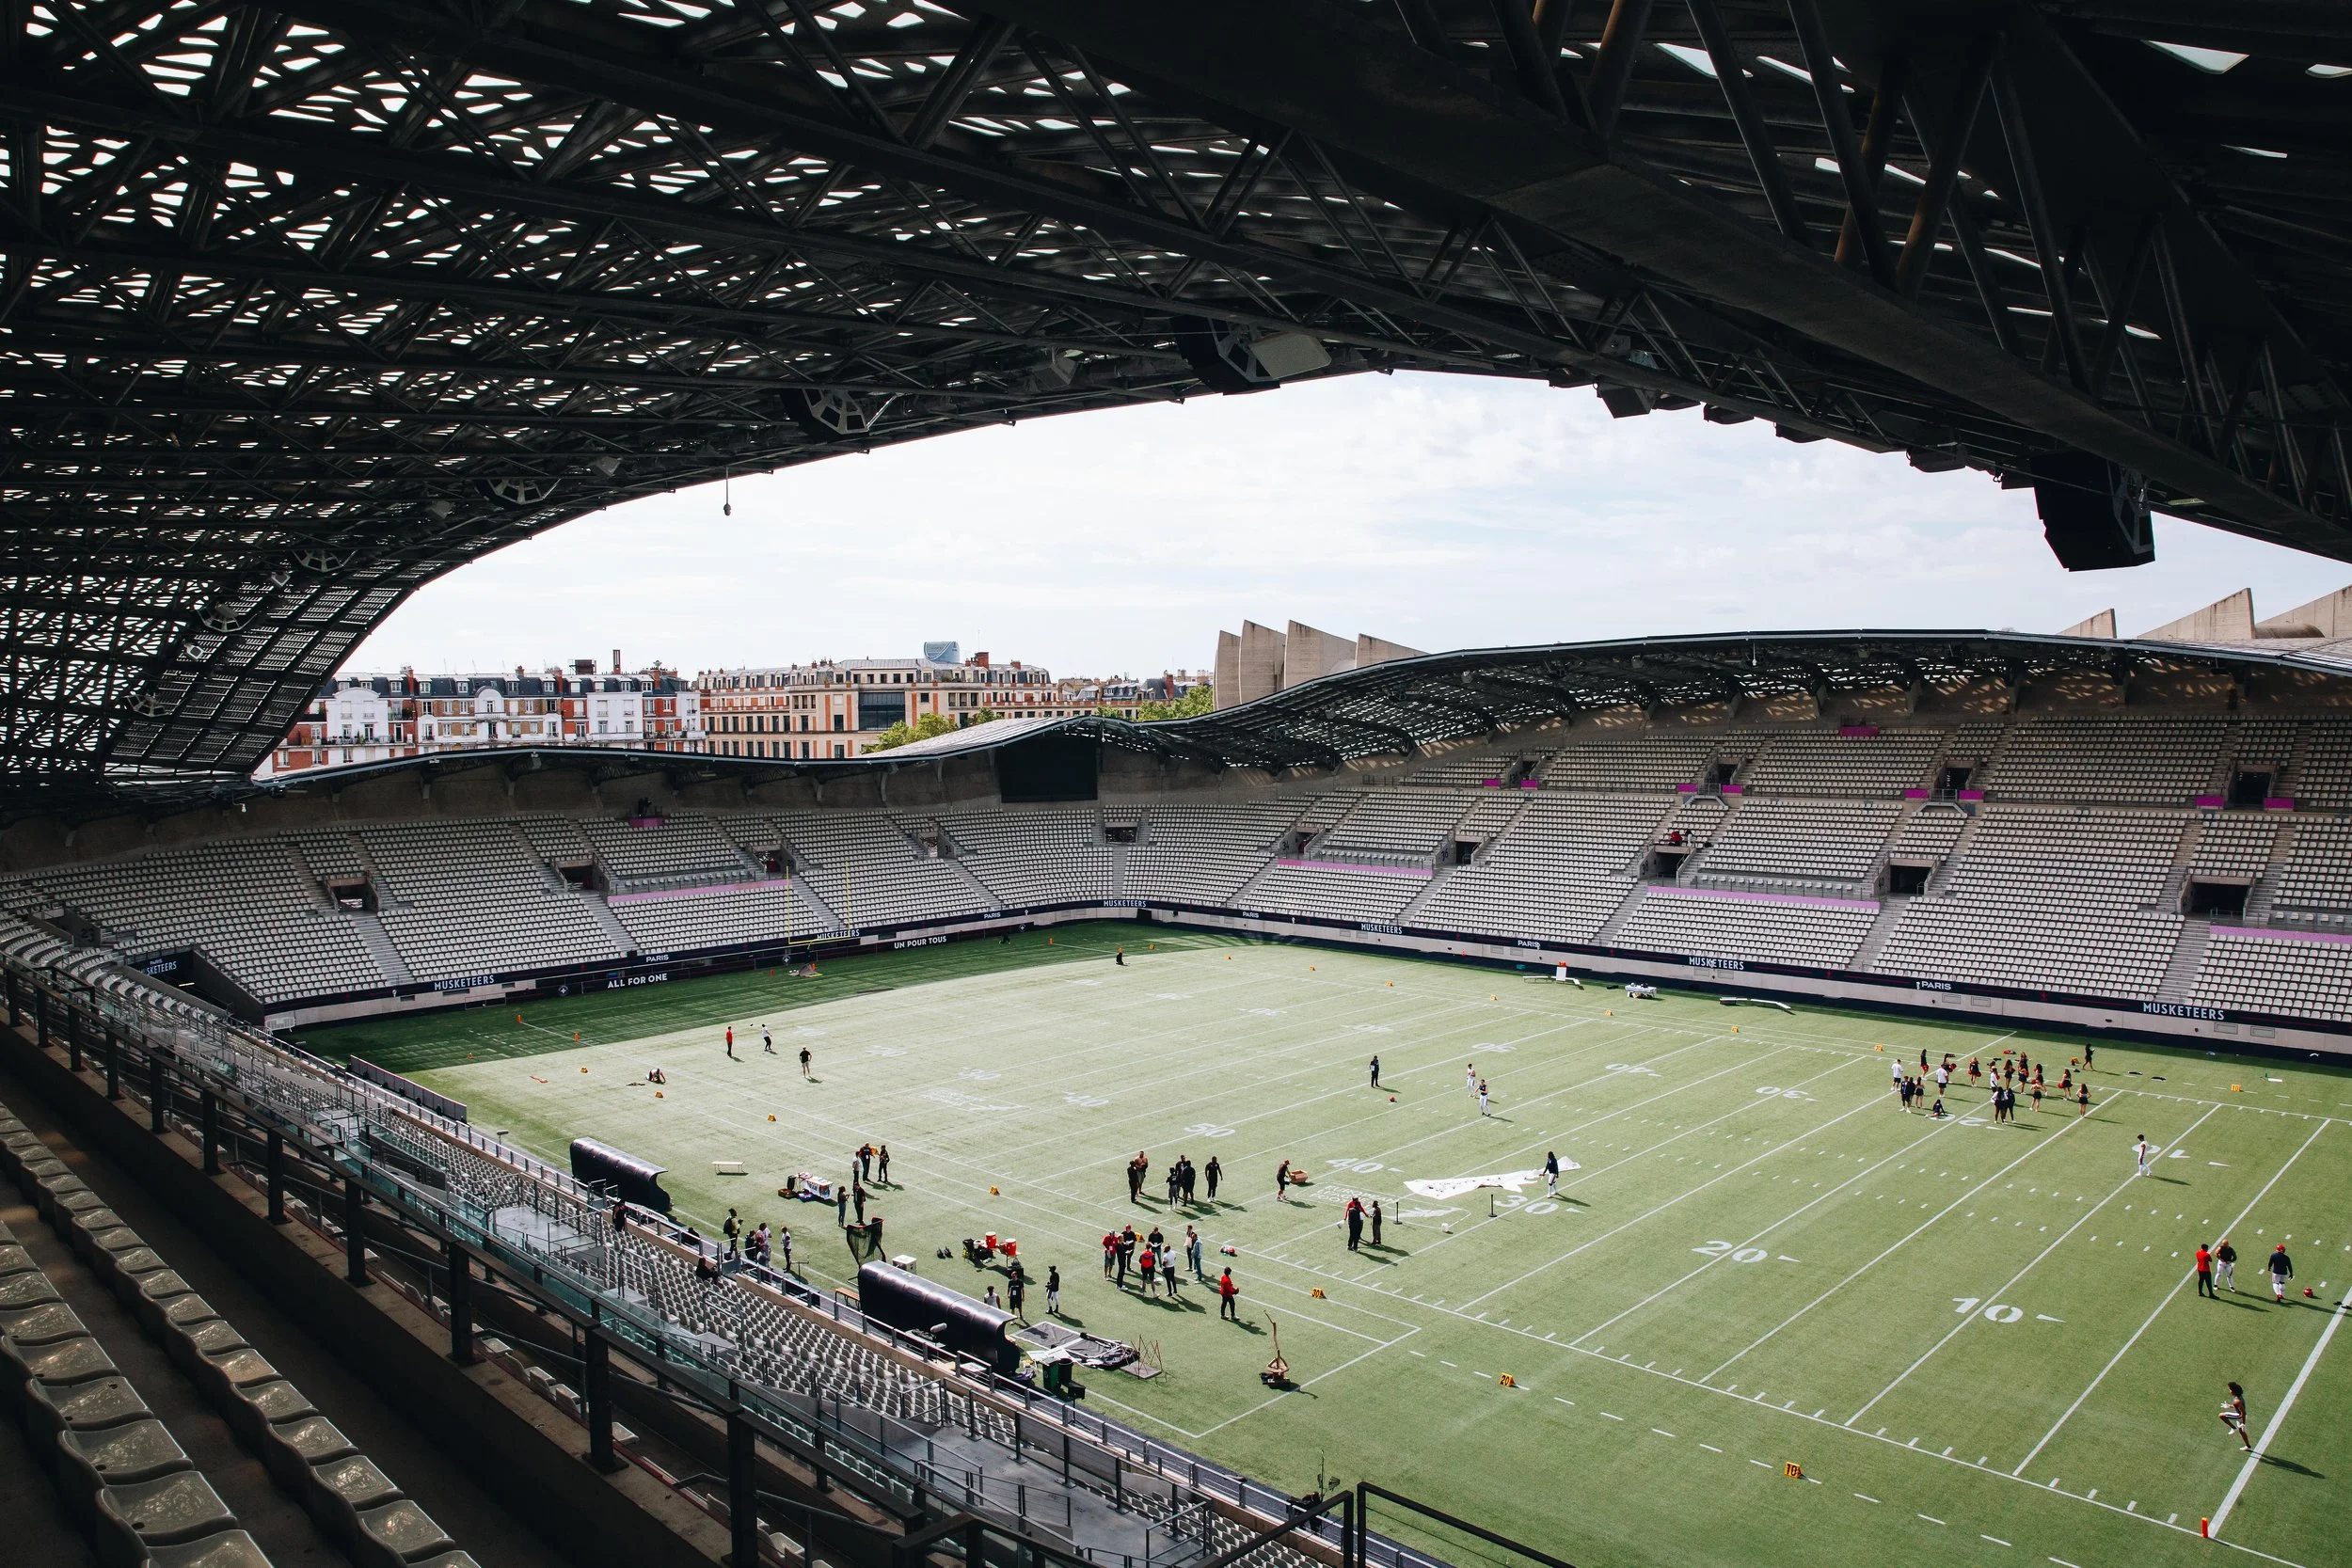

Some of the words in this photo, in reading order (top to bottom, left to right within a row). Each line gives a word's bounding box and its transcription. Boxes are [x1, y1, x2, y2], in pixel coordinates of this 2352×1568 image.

[1104, 899, 1146, 908] MUSKETEERS
[1361, 923, 1403, 934] MUSKETEERS
[907, 938, 927, 947] POUR
[929, 936, 947, 944] TOUS
[1518, 940, 1538, 948] PARIS
[1689, 957, 1744, 970] MUSKETEERS
[435, 974, 495, 990] MUSKETEERS
[628, 976, 646, 986] FOR
[648, 974, 668, 982] ONE
[1921, 981, 1951, 990] PARIS
[2142, 1003, 2225, 1021] MUSKETEERS
[1184, 1122, 1236, 1138] 50
[1326, 1158, 1384, 1174] 40
[1493, 1195, 1559, 1215] 30
[1691, 1240, 1768, 1263] 20
[1951, 1297, 2024, 1323] 10
[1501, 1375, 1509, 1386] 20
[1786, 1464, 1796, 1476] 10
